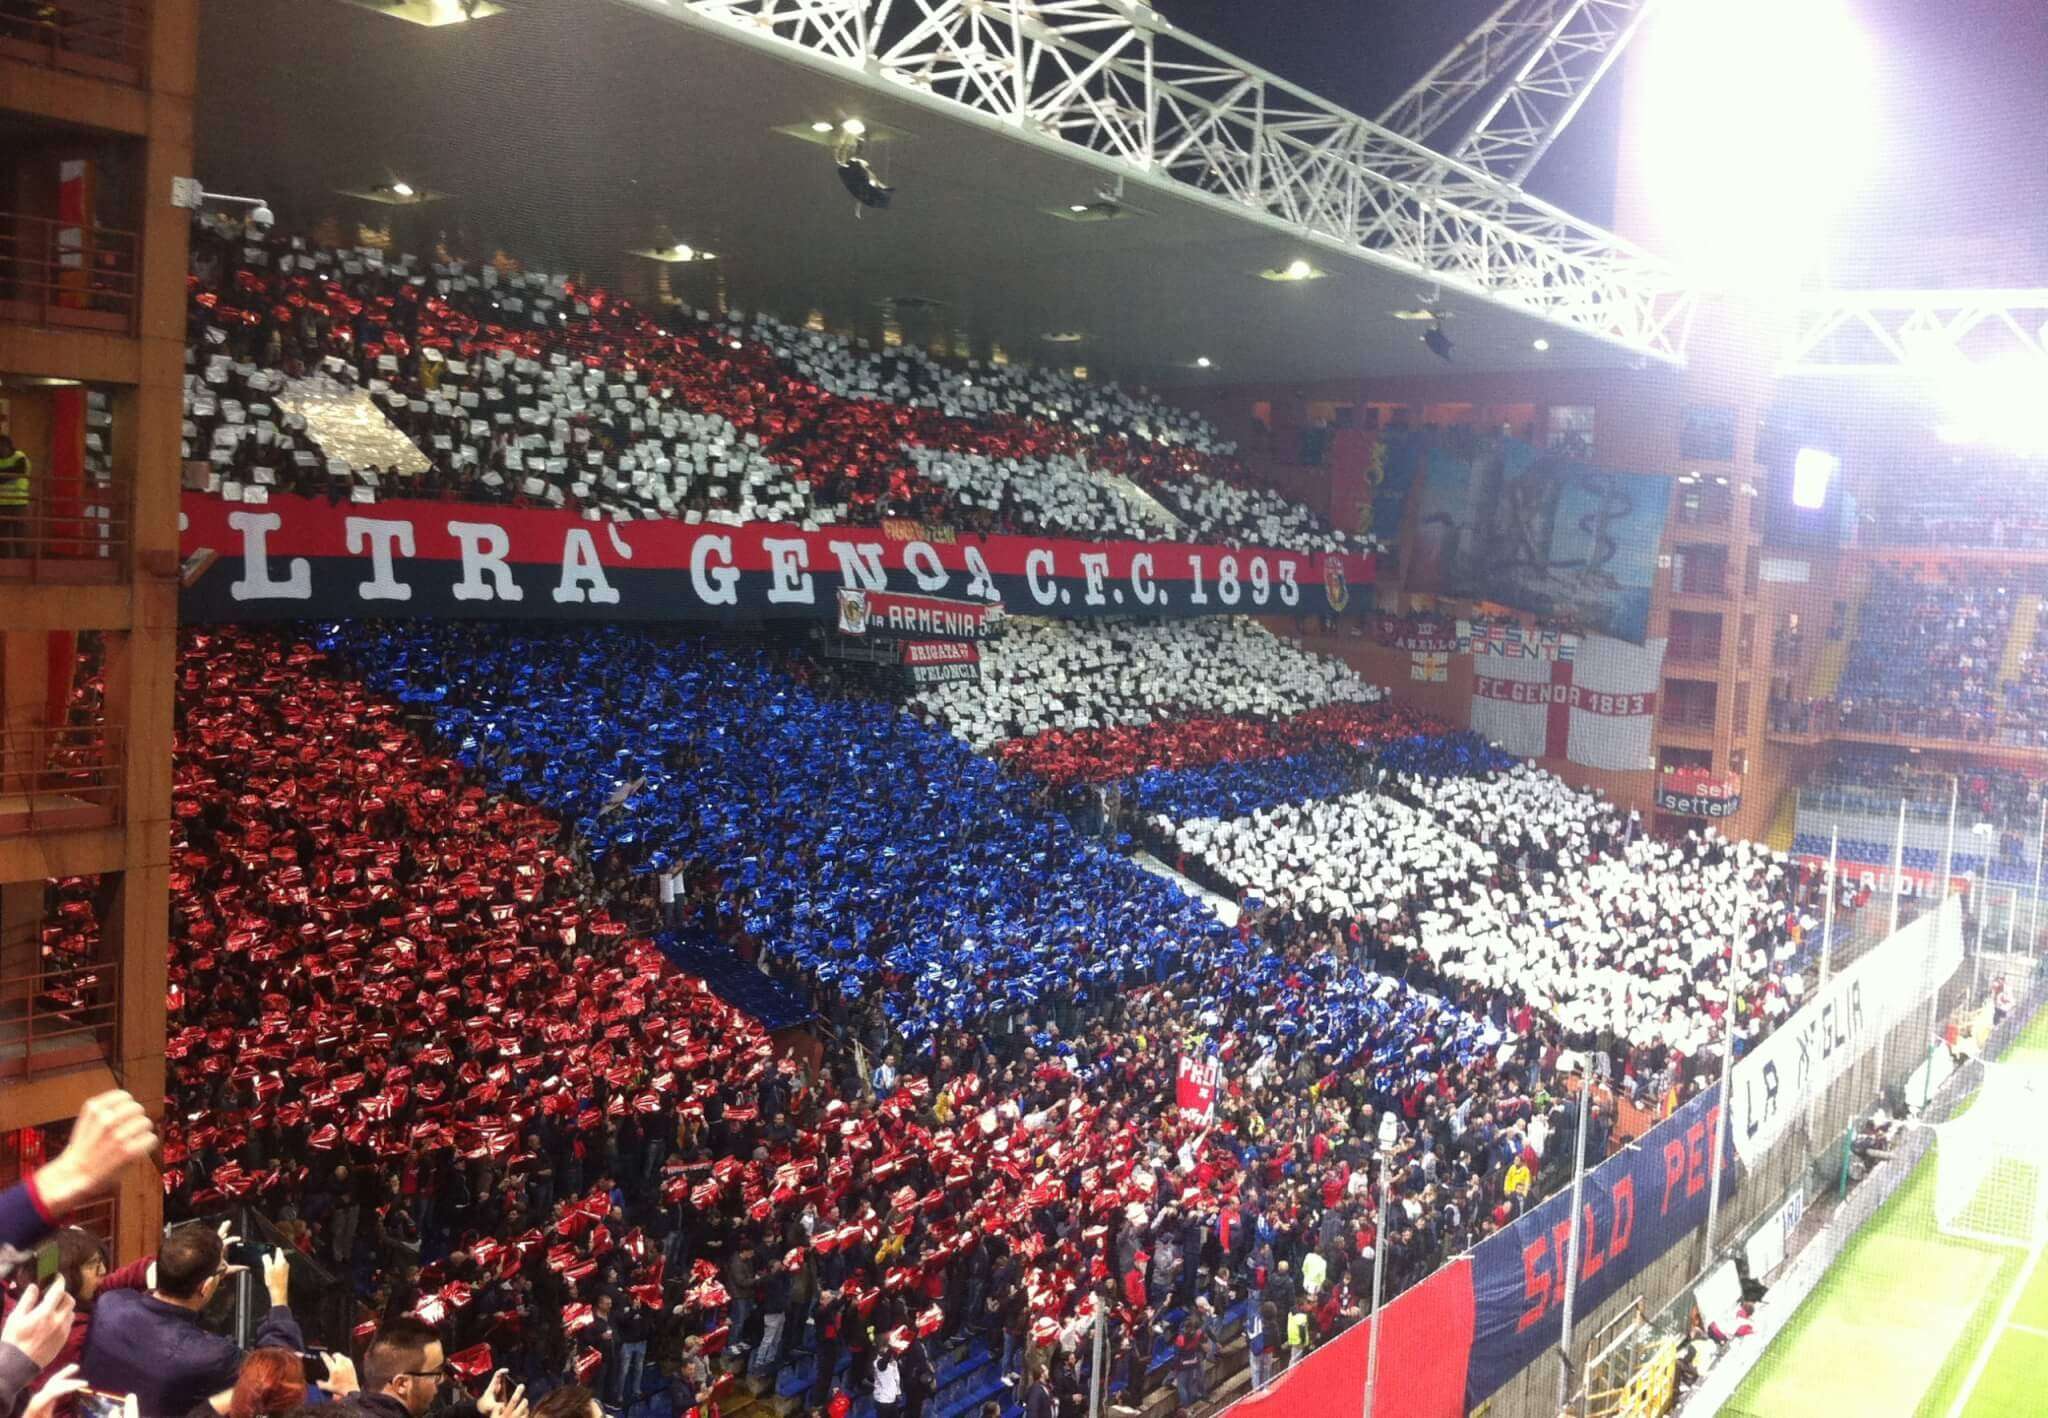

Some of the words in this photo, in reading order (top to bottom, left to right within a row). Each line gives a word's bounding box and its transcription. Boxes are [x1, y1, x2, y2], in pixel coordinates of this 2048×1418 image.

[690, 534, 1001, 604] GENOA
[1026, 548, 1168, 606] C.F.C.
[1188, 555, 1299, 606] 1893
[889, 605, 974, 638] ARMENIA
[1471, 623, 1564, 648] SESTRI
[909, 643, 962, 661] BRIGATA
[1456, 636, 1575, 663] PONENTE
[1511, 683, 1581, 706] GENOA
[1588, 692, 1645, 714] 1893
[1746, 1059, 1779, 1140] LA
